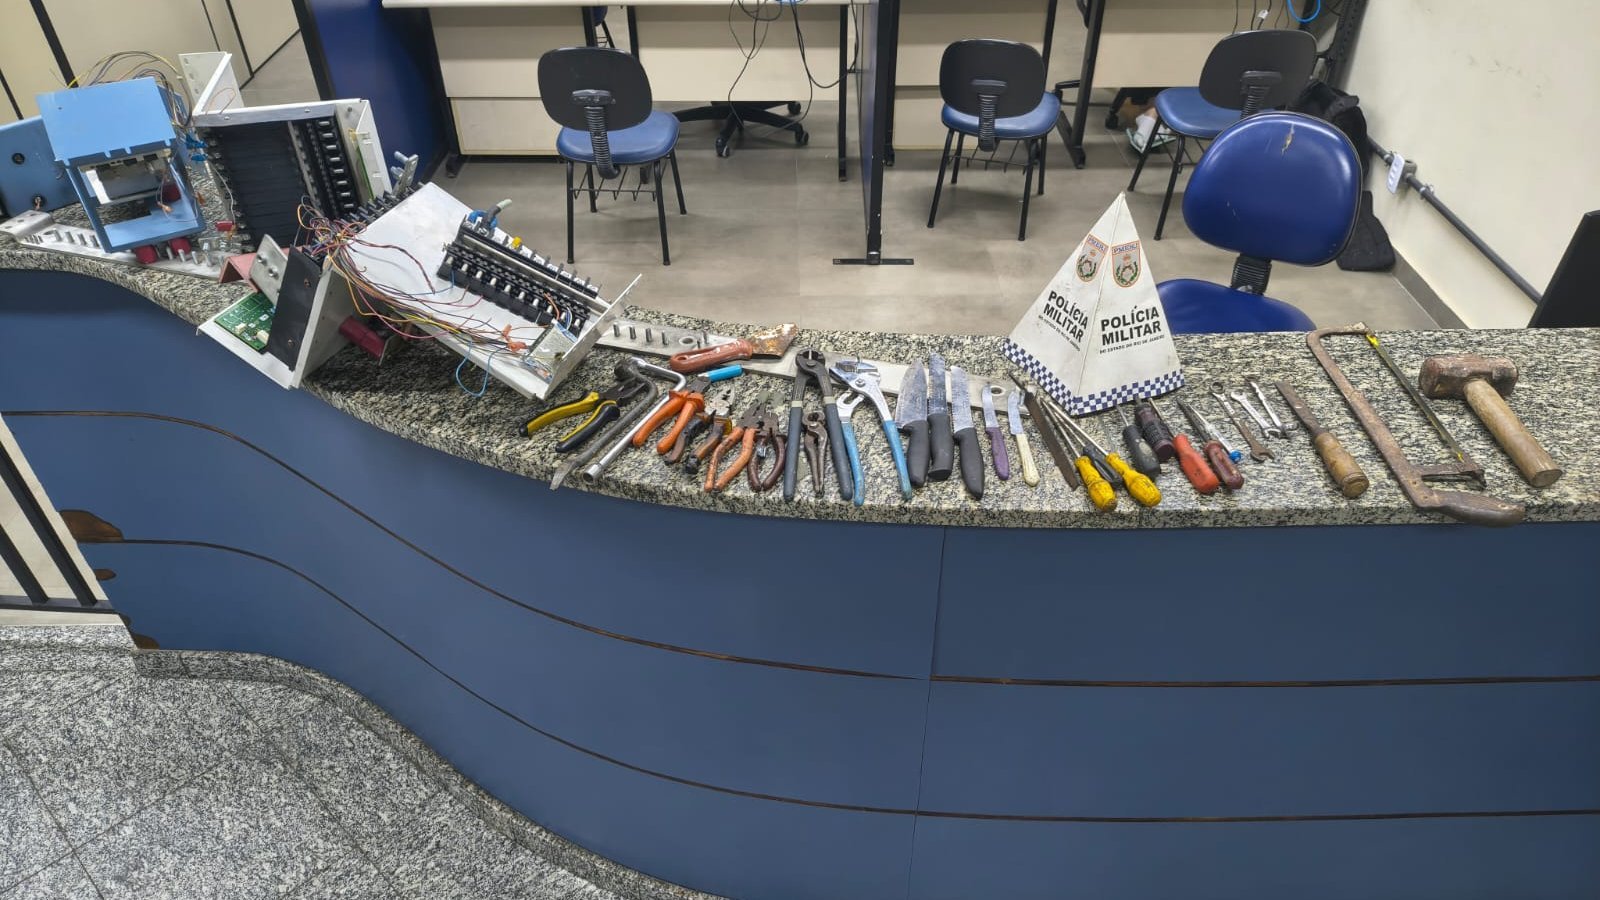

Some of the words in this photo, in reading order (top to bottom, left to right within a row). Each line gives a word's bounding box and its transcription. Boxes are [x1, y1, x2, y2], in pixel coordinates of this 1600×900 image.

[1043, 303, 1084, 343] MILITAR
[1048, 290, 1088, 330] POLÍCIA
[1101, 307, 1160, 331] POLÍCIA
[1102, 320, 1161, 346] MILITAR
